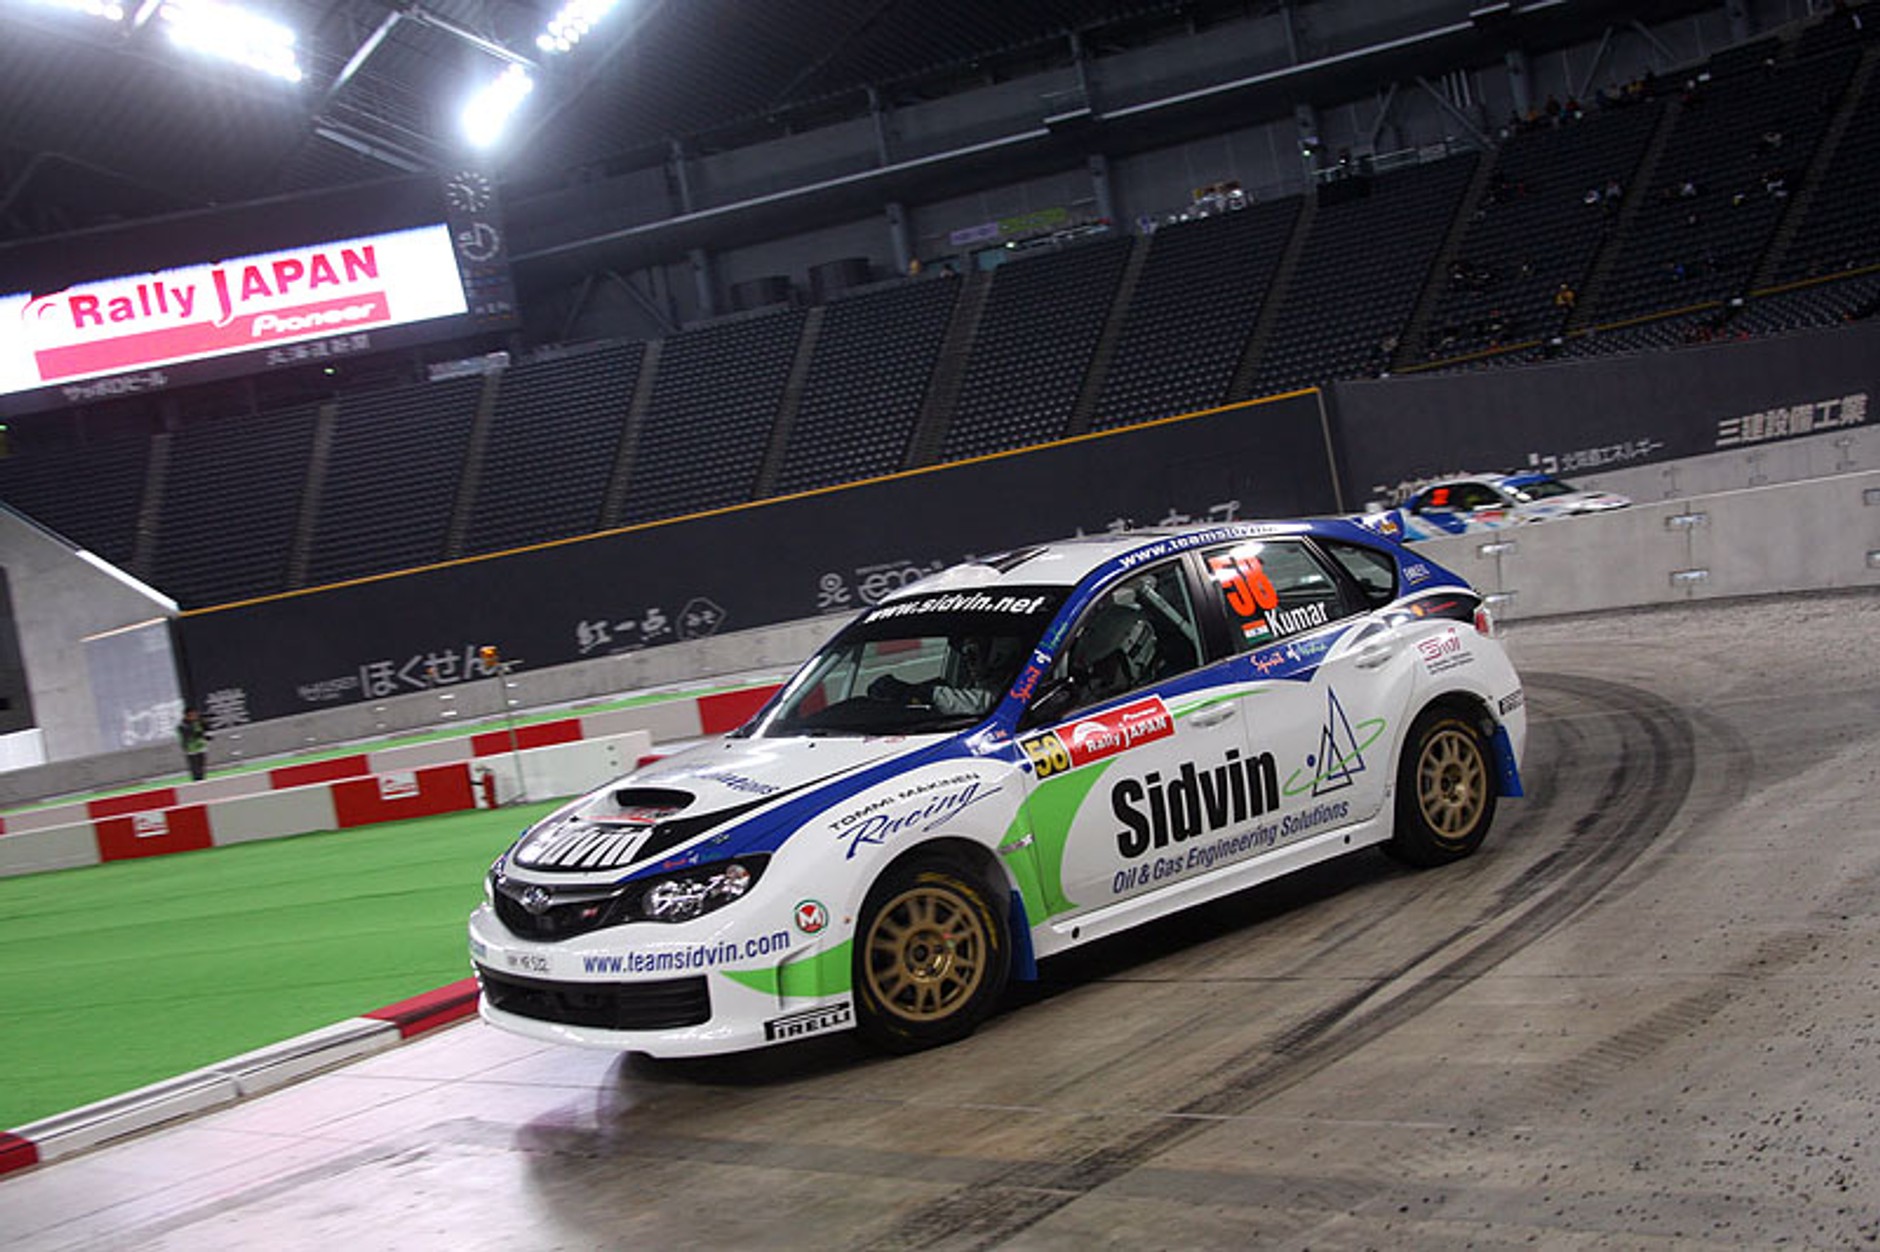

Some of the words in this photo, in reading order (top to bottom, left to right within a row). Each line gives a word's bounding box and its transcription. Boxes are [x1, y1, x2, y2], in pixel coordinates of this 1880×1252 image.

[68, 281, 196, 328] Rally
[211, 245, 380, 324] JAPAN
[251, 301, 377, 337] Pioneer
[863, 592, 1046, 624] www.sidvin.net
[1207, 556, 1279, 617] 58
[1264, 601, 1329, 637] Kumar
[1025, 734, 1069, 777] 58
[1085, 733, 1121, 753] Rally
[1119, 716, 1167, 748] JAPAN
[828, 796, 895, 831] TOMMI
[837, 782, 990, 860] Racing
[1111, 748, 1280, 859] Sidvin
[1113, 866, 1138, 894] Oil
[1138, 862, 1150, 885] &
[1153, 854, 1184, 881] Gas
[1186, 823, 1277, 869] Engineering
[1281, 800, 1349, 837] Solutions
[583, 930, 791, 973] www.teamsidvin.com
[764, 1001, 851, 1041] PIRELLI
